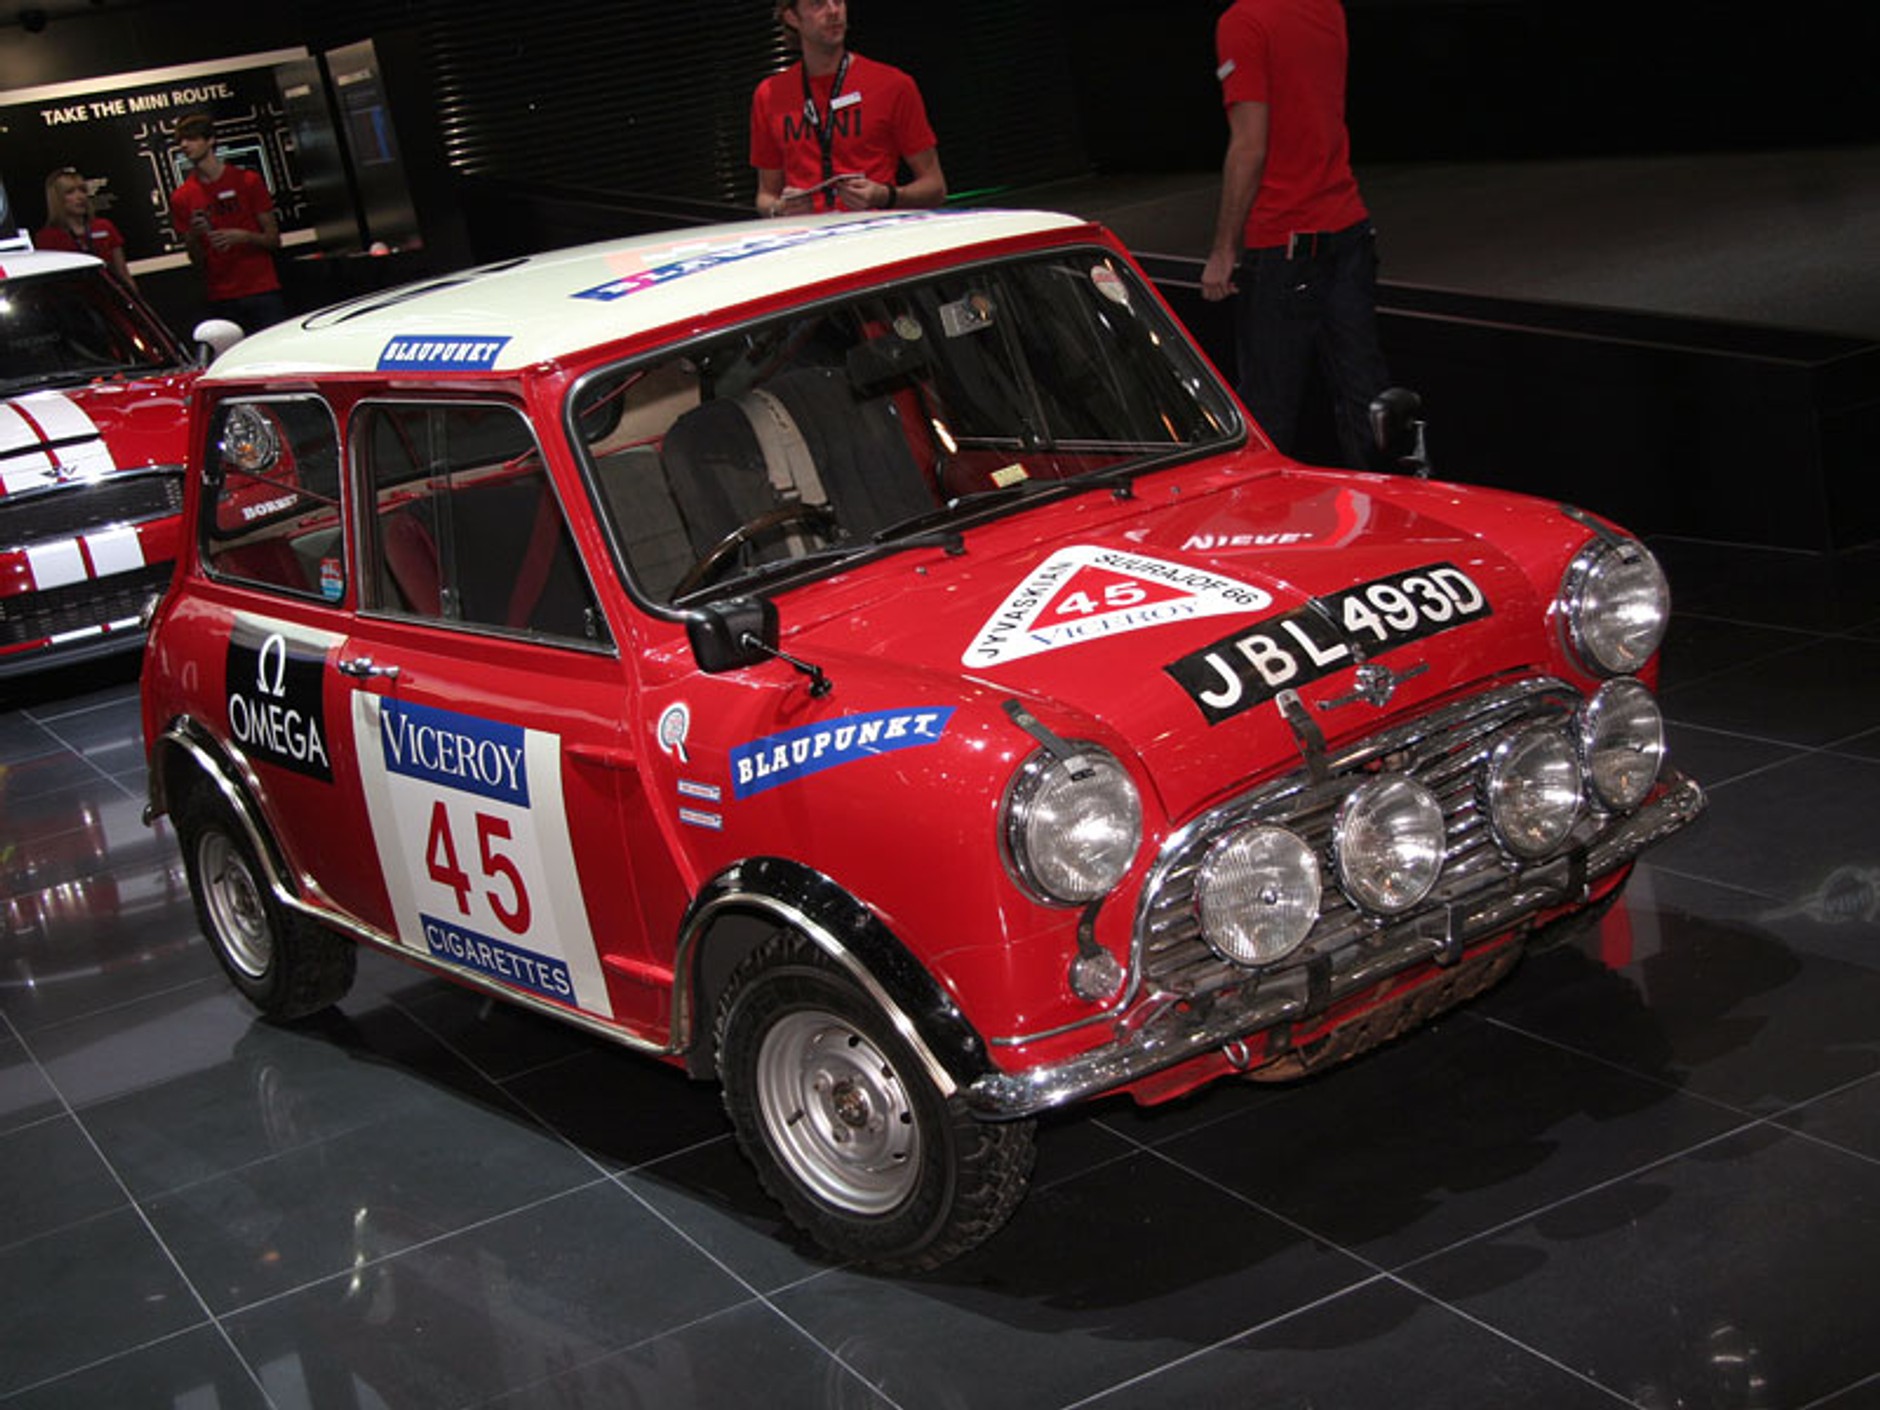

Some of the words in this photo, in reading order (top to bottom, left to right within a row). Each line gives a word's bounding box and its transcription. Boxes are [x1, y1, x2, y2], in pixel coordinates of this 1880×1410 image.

[41, 104, 88, 126] TAKE
[89, 98, 126, 119] THE
[128, 92, 170, 113] MINI
[171, 82, 235, 105] ROUTE.
[784, 108, 863, 142] MNI
[383, 342, 500, 361] BLAUPUNKT
[1055, 582, 1148, 615] 45
[1222, 587, 1260, 606] 66
[1199, 619, 1350, 709] JBL
[1343, 567, 1484, 641] 493D
[228, 692, 330, 769] OMEGA
[381, 708, 523, 791] VICEROY
[737, 713, 940, 785] BLAUPUNKT
[425, 800, 532, 935] 45
[426, 924, 571, 997] CIGARETTES
